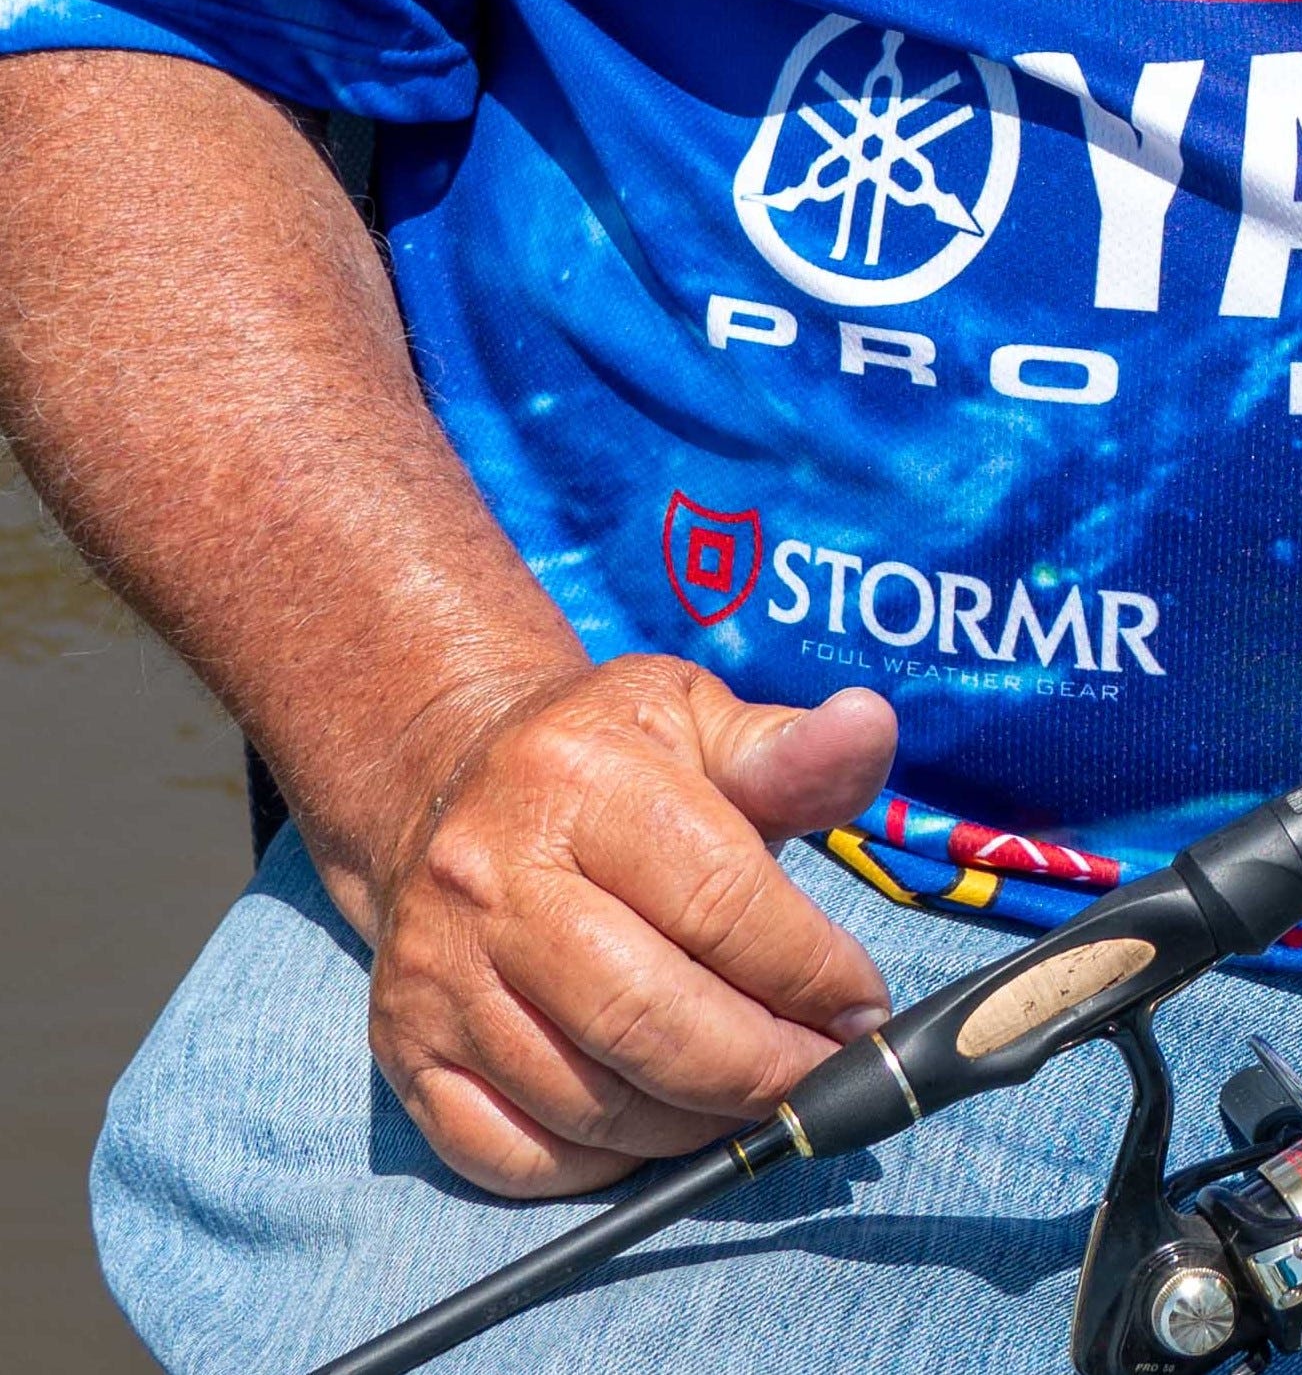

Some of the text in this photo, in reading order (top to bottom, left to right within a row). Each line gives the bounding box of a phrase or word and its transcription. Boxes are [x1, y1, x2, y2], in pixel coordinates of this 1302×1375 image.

[705, 293, 1121, 405] PRO
[767, 537, 1168, 677] STORMR
[801, 639, 1121, 701] FOUL WEATHER GEAR
